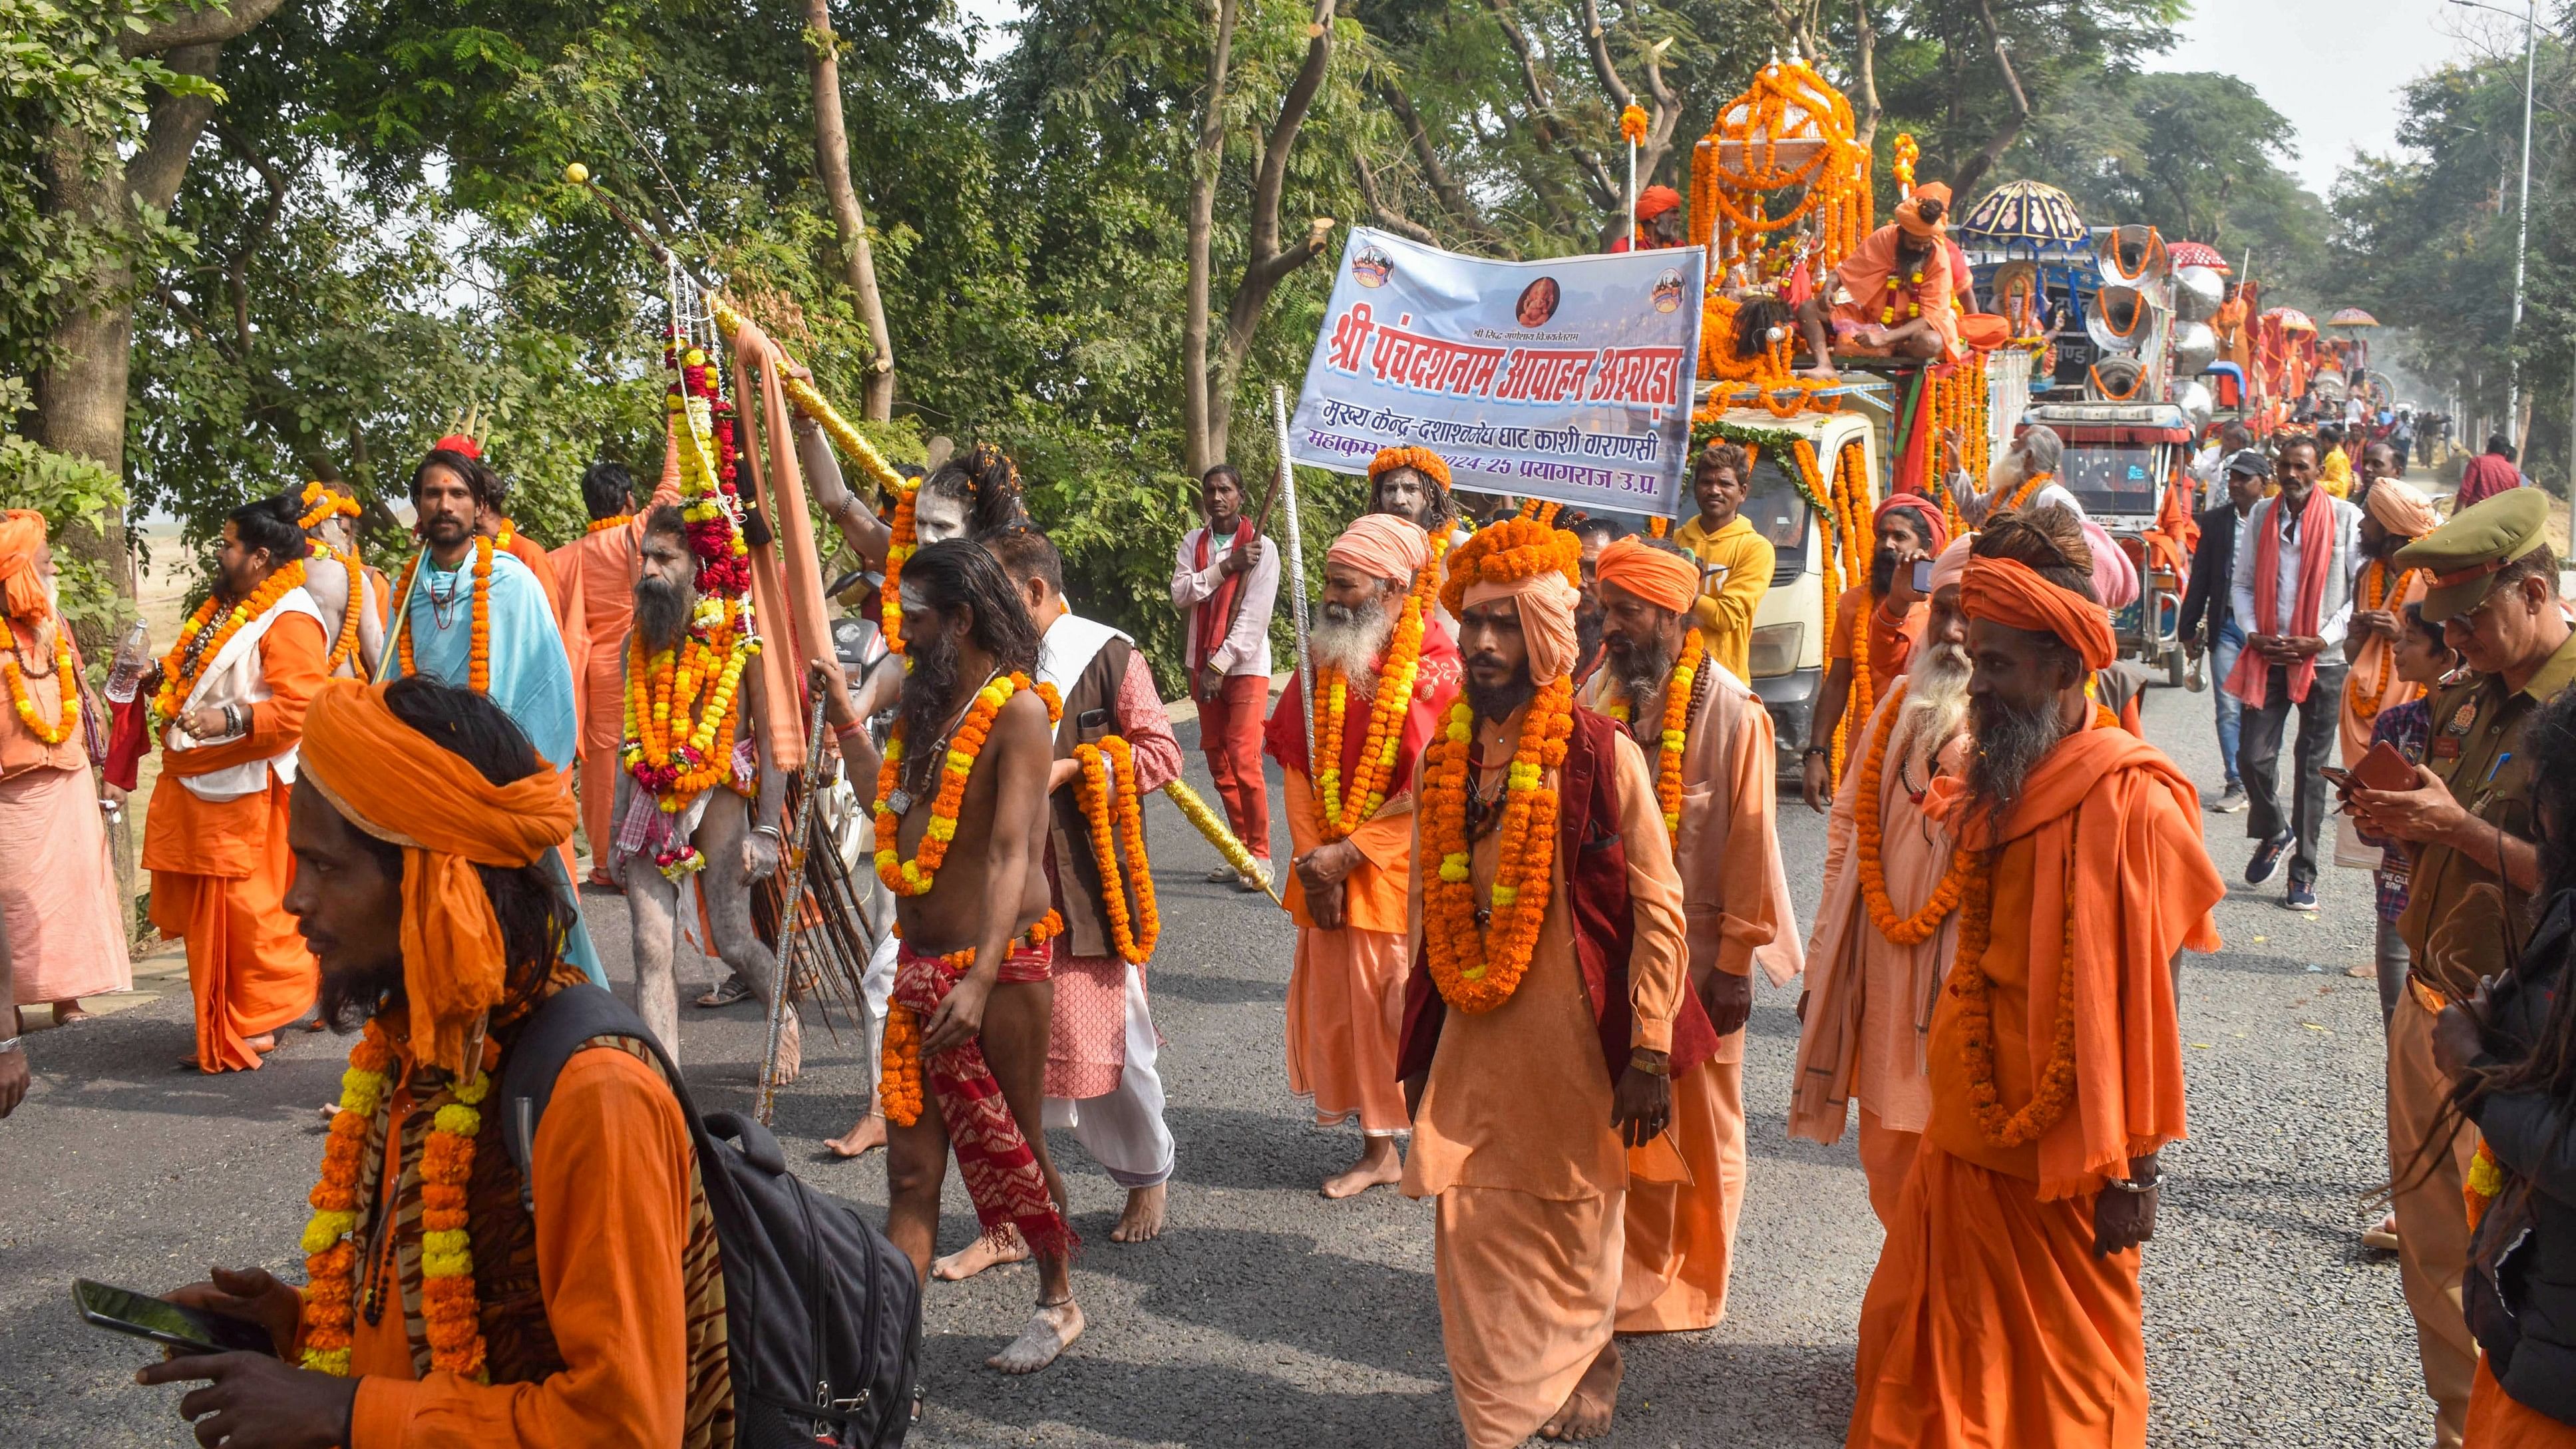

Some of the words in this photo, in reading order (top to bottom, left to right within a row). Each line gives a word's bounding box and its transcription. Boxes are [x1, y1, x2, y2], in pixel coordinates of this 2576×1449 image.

[1473, 328, 1484, 338] श्री
[1505, 330, 1534, 341] गणेशाय
[1329, 302, 1375, 372] श्री
[1372, 314, 1507, 397] पंचदशनाम
[1495, 349, 1598, 401] आवाहन
[1589, 347, 1684, 421] अखाड़ा
[1323, 399, 1371, 426] मुख्य
[1498, 427, 1530, 449] घाट
[1533, 425, 1581, 453] काशी
[1584, 432, 1659, 461] वाराणसी
[1519, 460, 1614, 489] प्रयागराज
[1618, 472, 1659, 495] उ.प्र.
